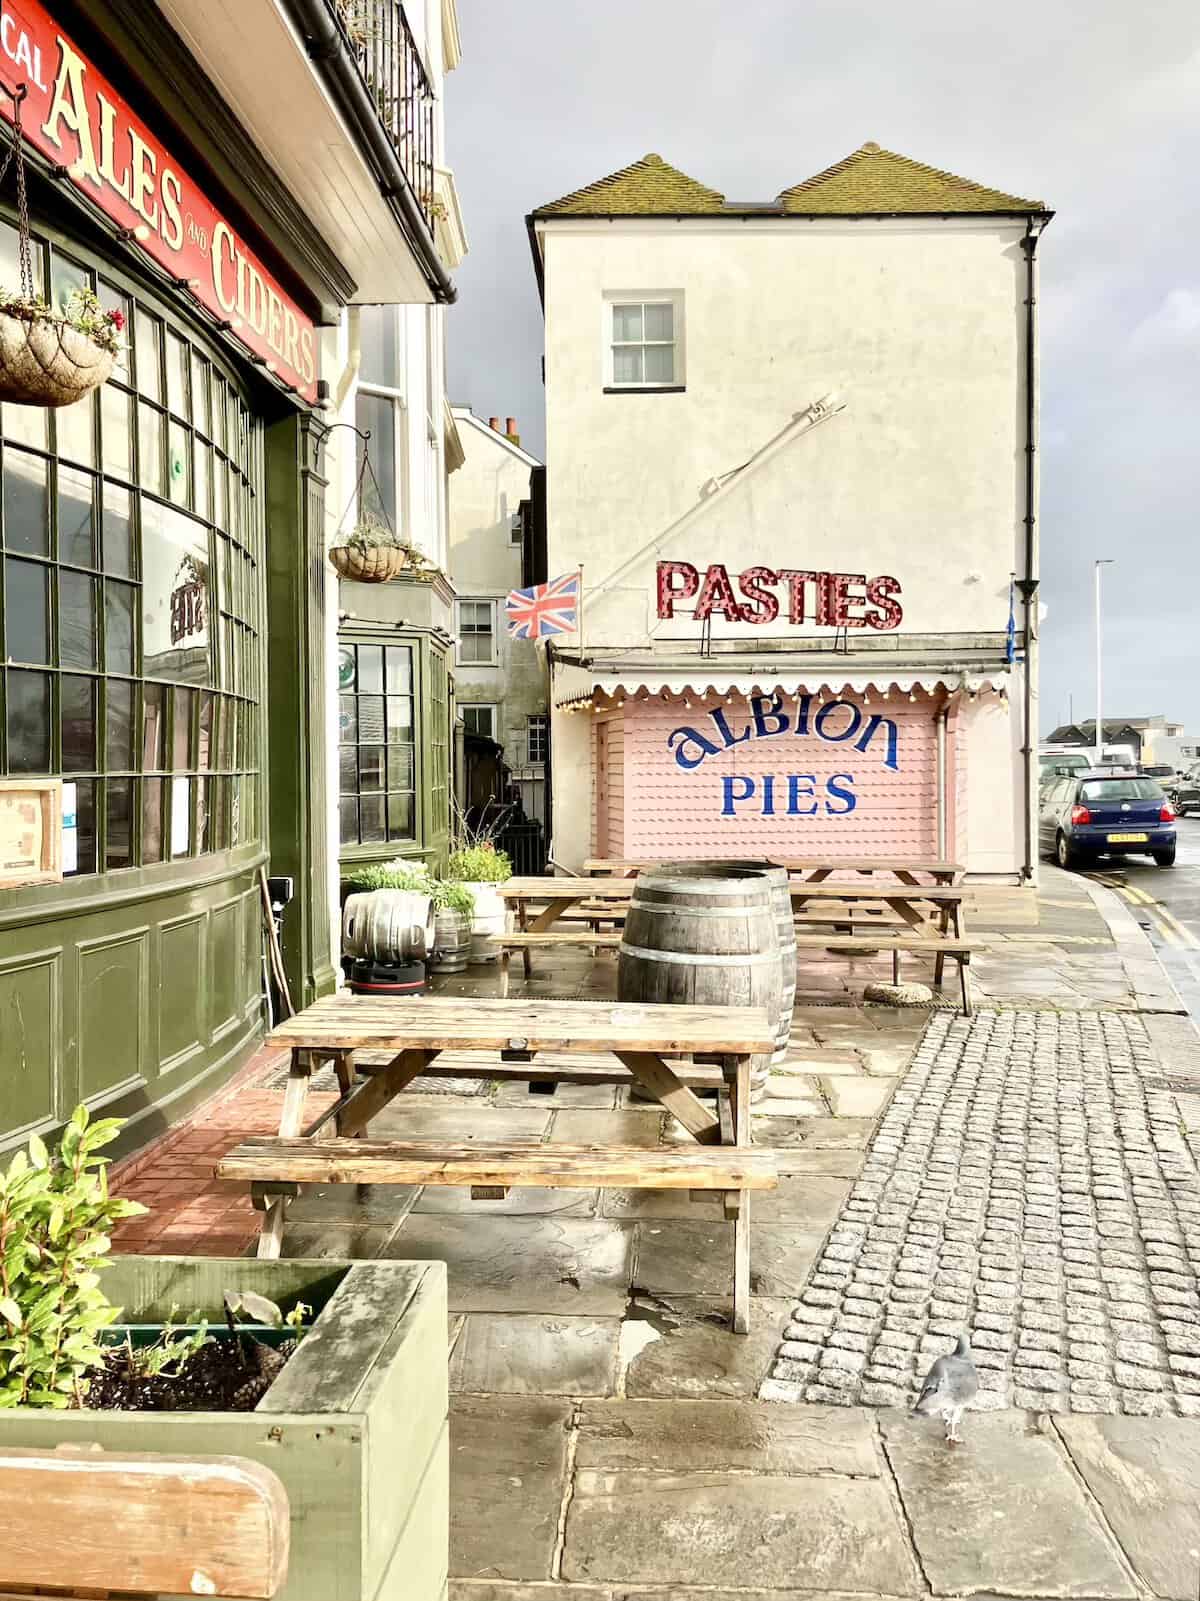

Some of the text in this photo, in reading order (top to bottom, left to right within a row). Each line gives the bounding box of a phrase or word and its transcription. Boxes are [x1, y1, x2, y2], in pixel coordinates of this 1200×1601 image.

[42, 34, 183, 251] ALES
[211, 221, 314, 385] CIDERS
[656, 560, 903, 630] PASTIES
[720, 773, 857, 816] PIES
